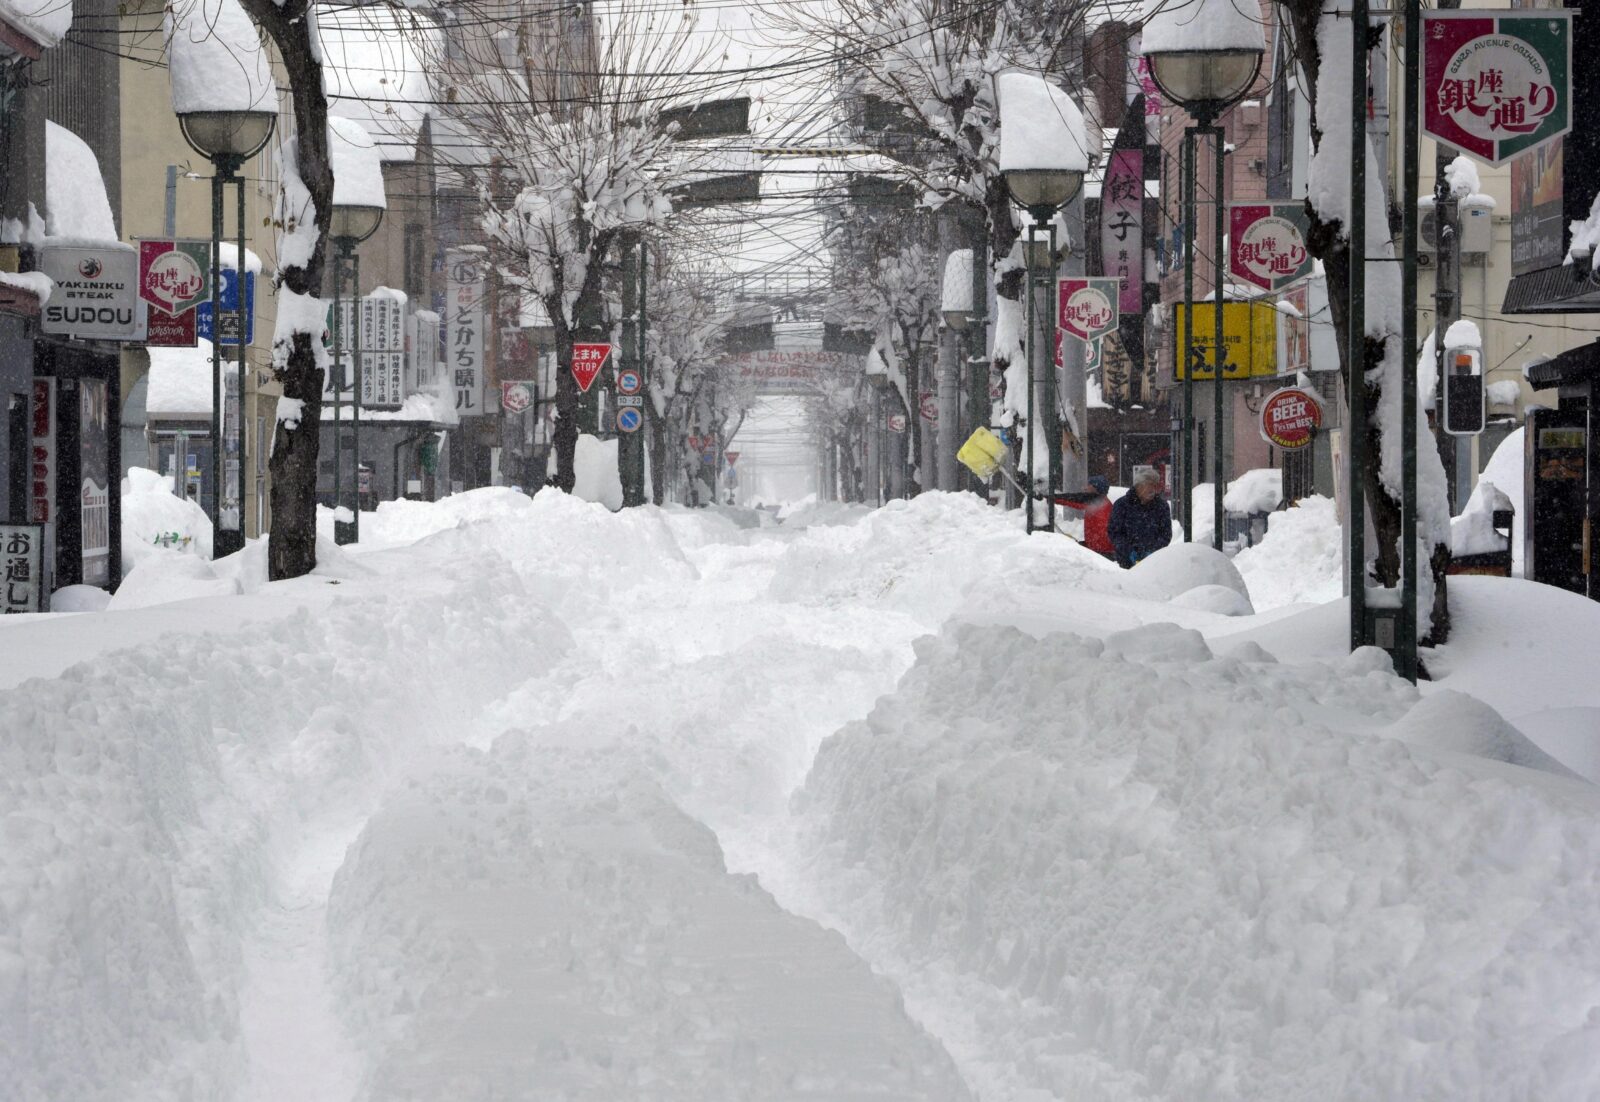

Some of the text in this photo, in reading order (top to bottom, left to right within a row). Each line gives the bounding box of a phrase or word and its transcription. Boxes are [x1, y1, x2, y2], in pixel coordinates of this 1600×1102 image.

[1451, 49, 1472, 74] GINZA
[1474, 39, 1510, 51] AVENUE
[1438, 68, 1555, 132] 銀座通り
[1108, 173, 1139, 241] 餃子
[1237, 237, 1306, 274] 銀座通り
[56, 281, 125, 290] YAKINIKU
[66, 291, 114, 299] STEAK
[148, 267, 203, 300] 銀座通り
[46, 306, 132, 325] SUDOU
[1065, 302, 1113, 328] 銀座通り
[454, 305, 475, 410] とかち晴ル
[574, 362, 597, 371] STOP
[1277, 396, 1298, 406] DRINK
[6, 532, 31, 614] お通し
